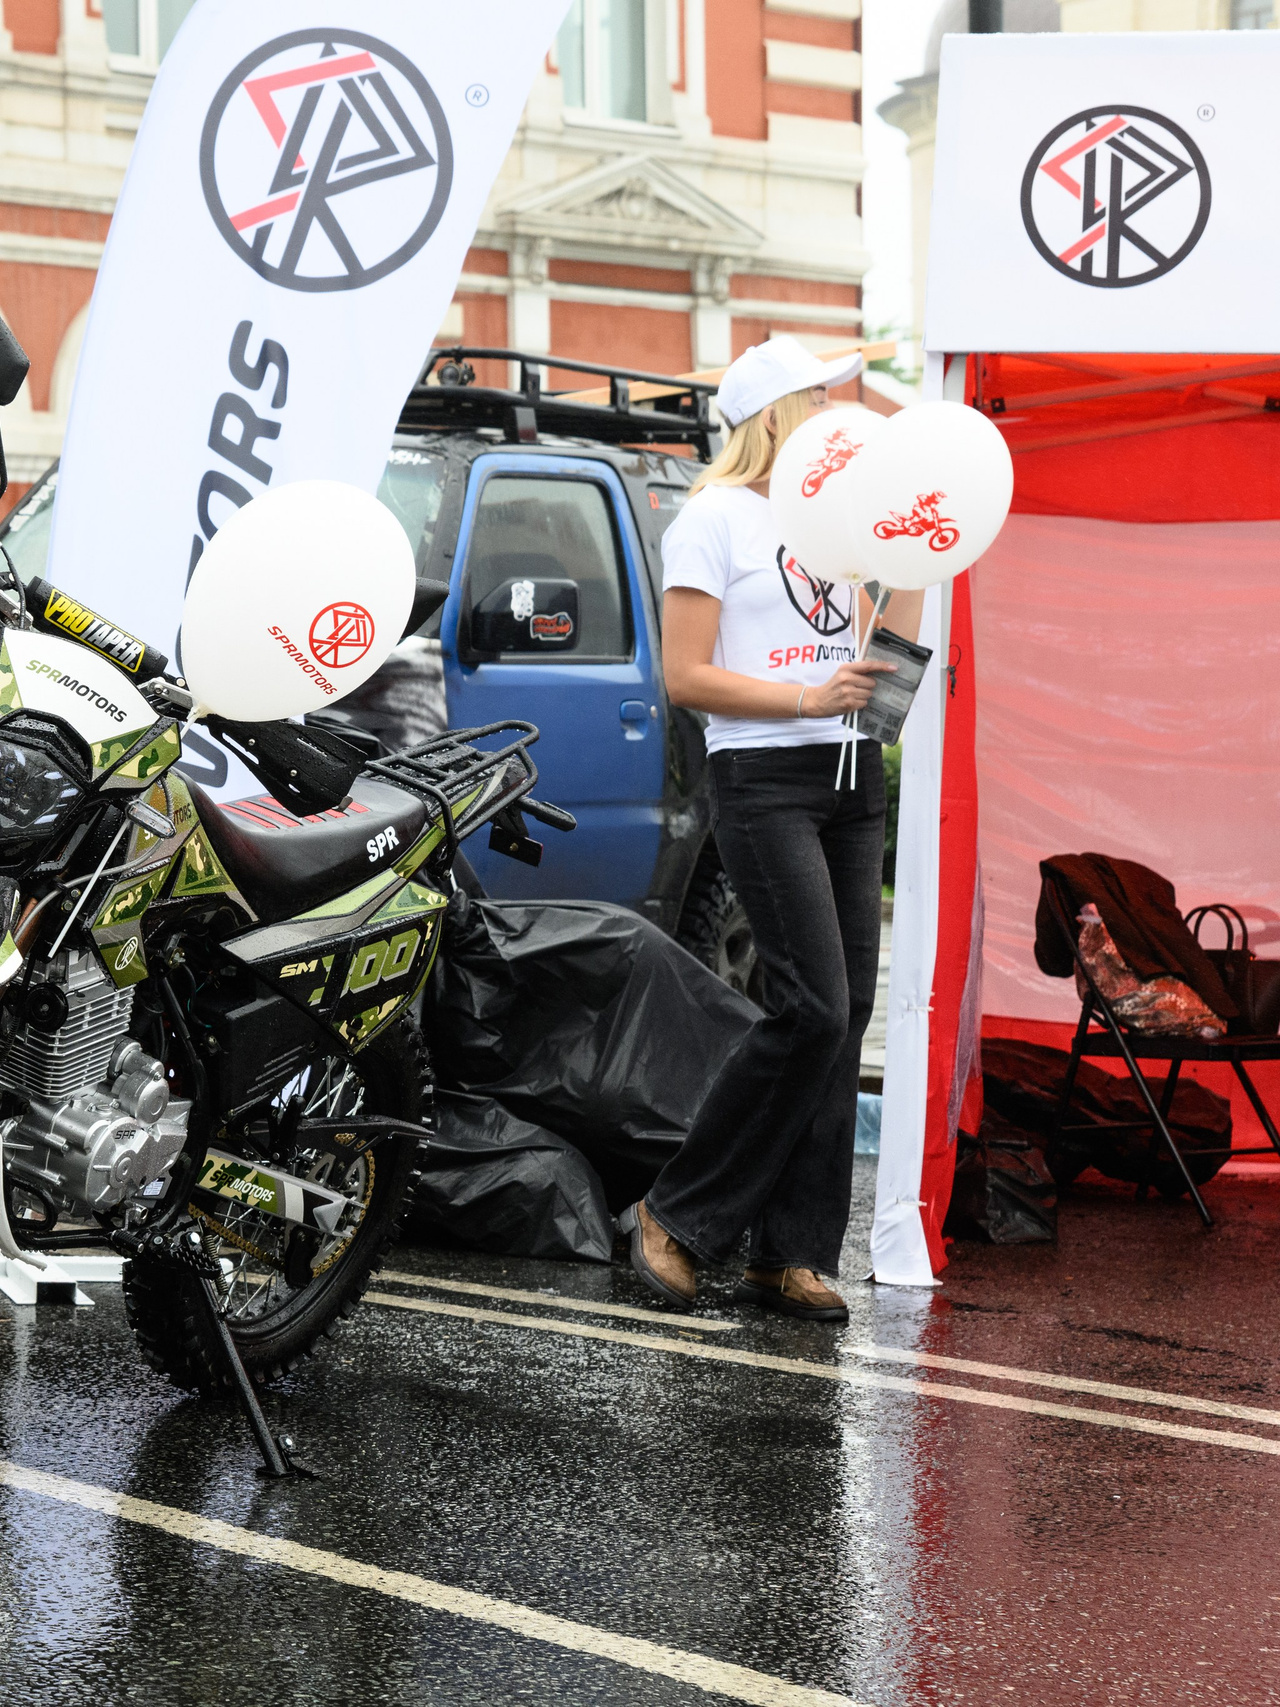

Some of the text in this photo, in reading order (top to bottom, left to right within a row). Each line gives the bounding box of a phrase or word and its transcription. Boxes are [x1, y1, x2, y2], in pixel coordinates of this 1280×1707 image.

[47, 596, 142, 666] PROTAPER
[267, 625, 338, 696] SPRMOTORS
[25, 659, 127, 723] SPRMOTORS
[366, 825, 400, 863] SPR
[279, 959, 319, 979] SM
[115, 1130, 137, 1140] SPR
[209, 1169, 275, 1202] SPRMOTORS
